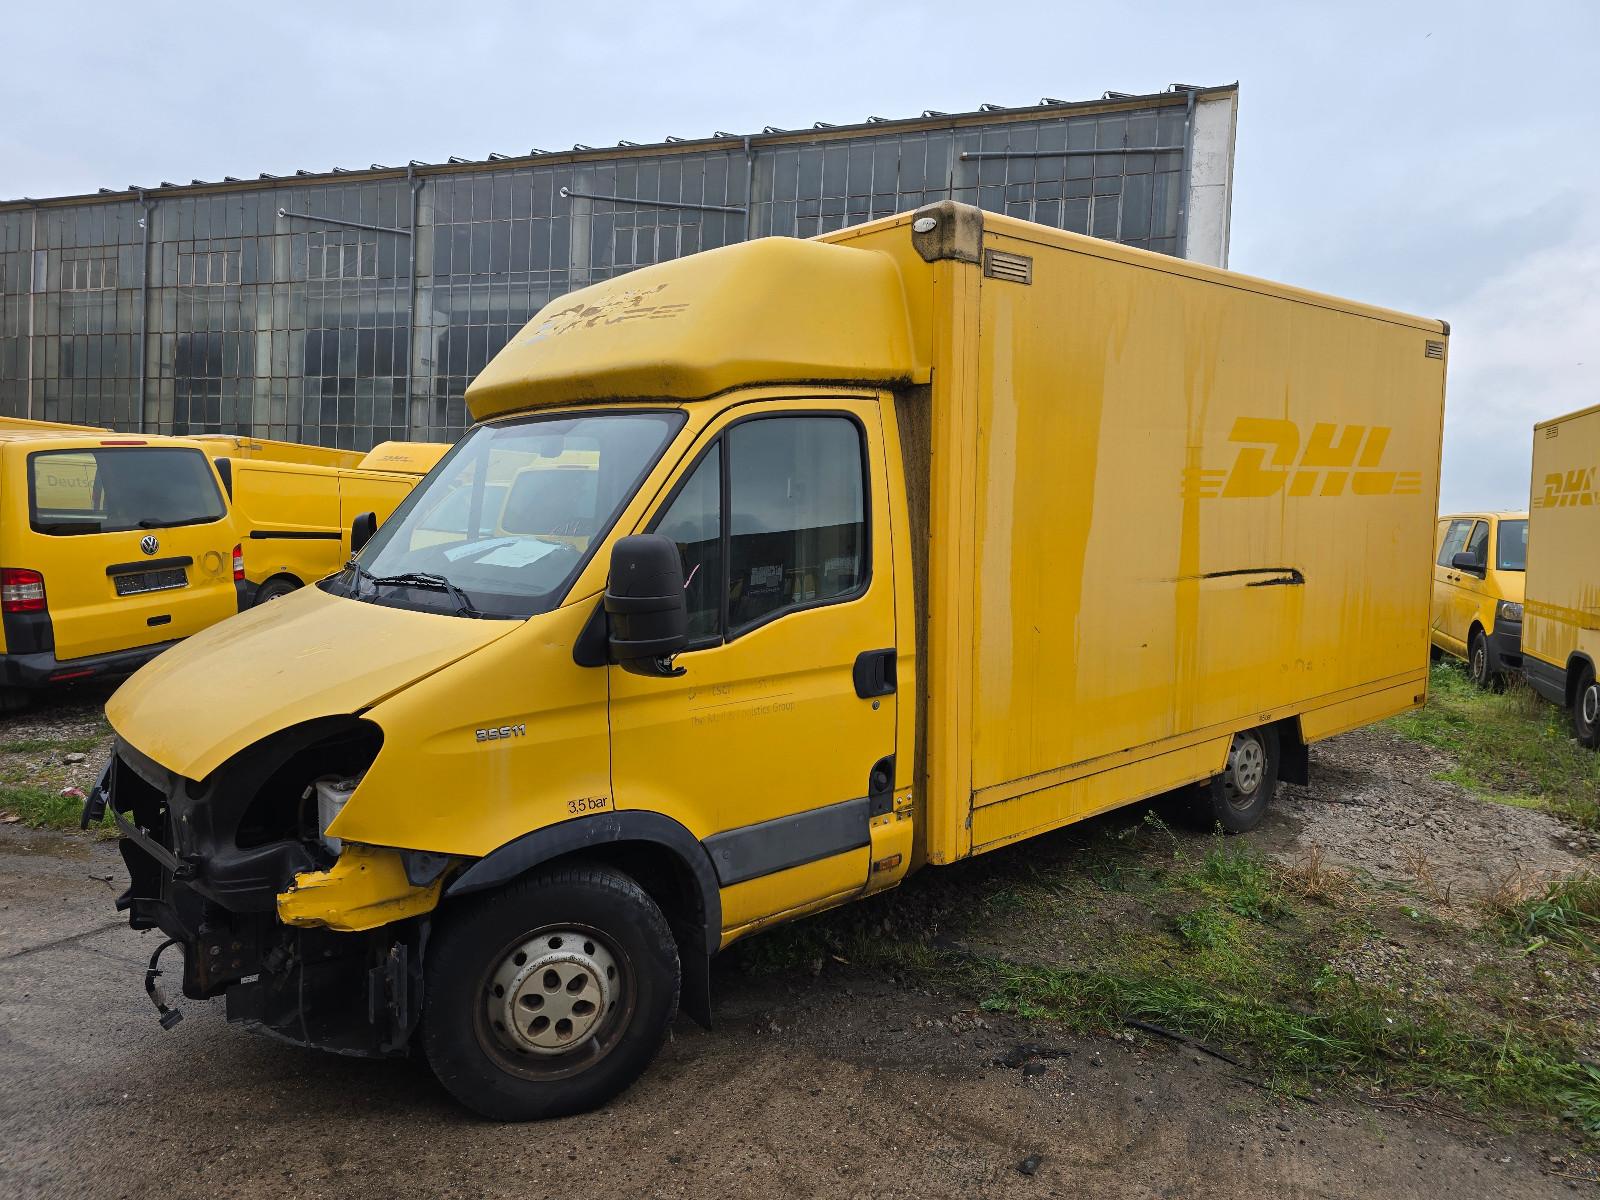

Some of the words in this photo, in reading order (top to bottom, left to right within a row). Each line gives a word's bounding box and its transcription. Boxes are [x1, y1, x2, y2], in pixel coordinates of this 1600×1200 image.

[1221, 416, 1393, 498] DHL
[772, 701, 795, 713] Group
[476, 724, 526, 742] 35S11
[588, 797, 607, 810] bar
